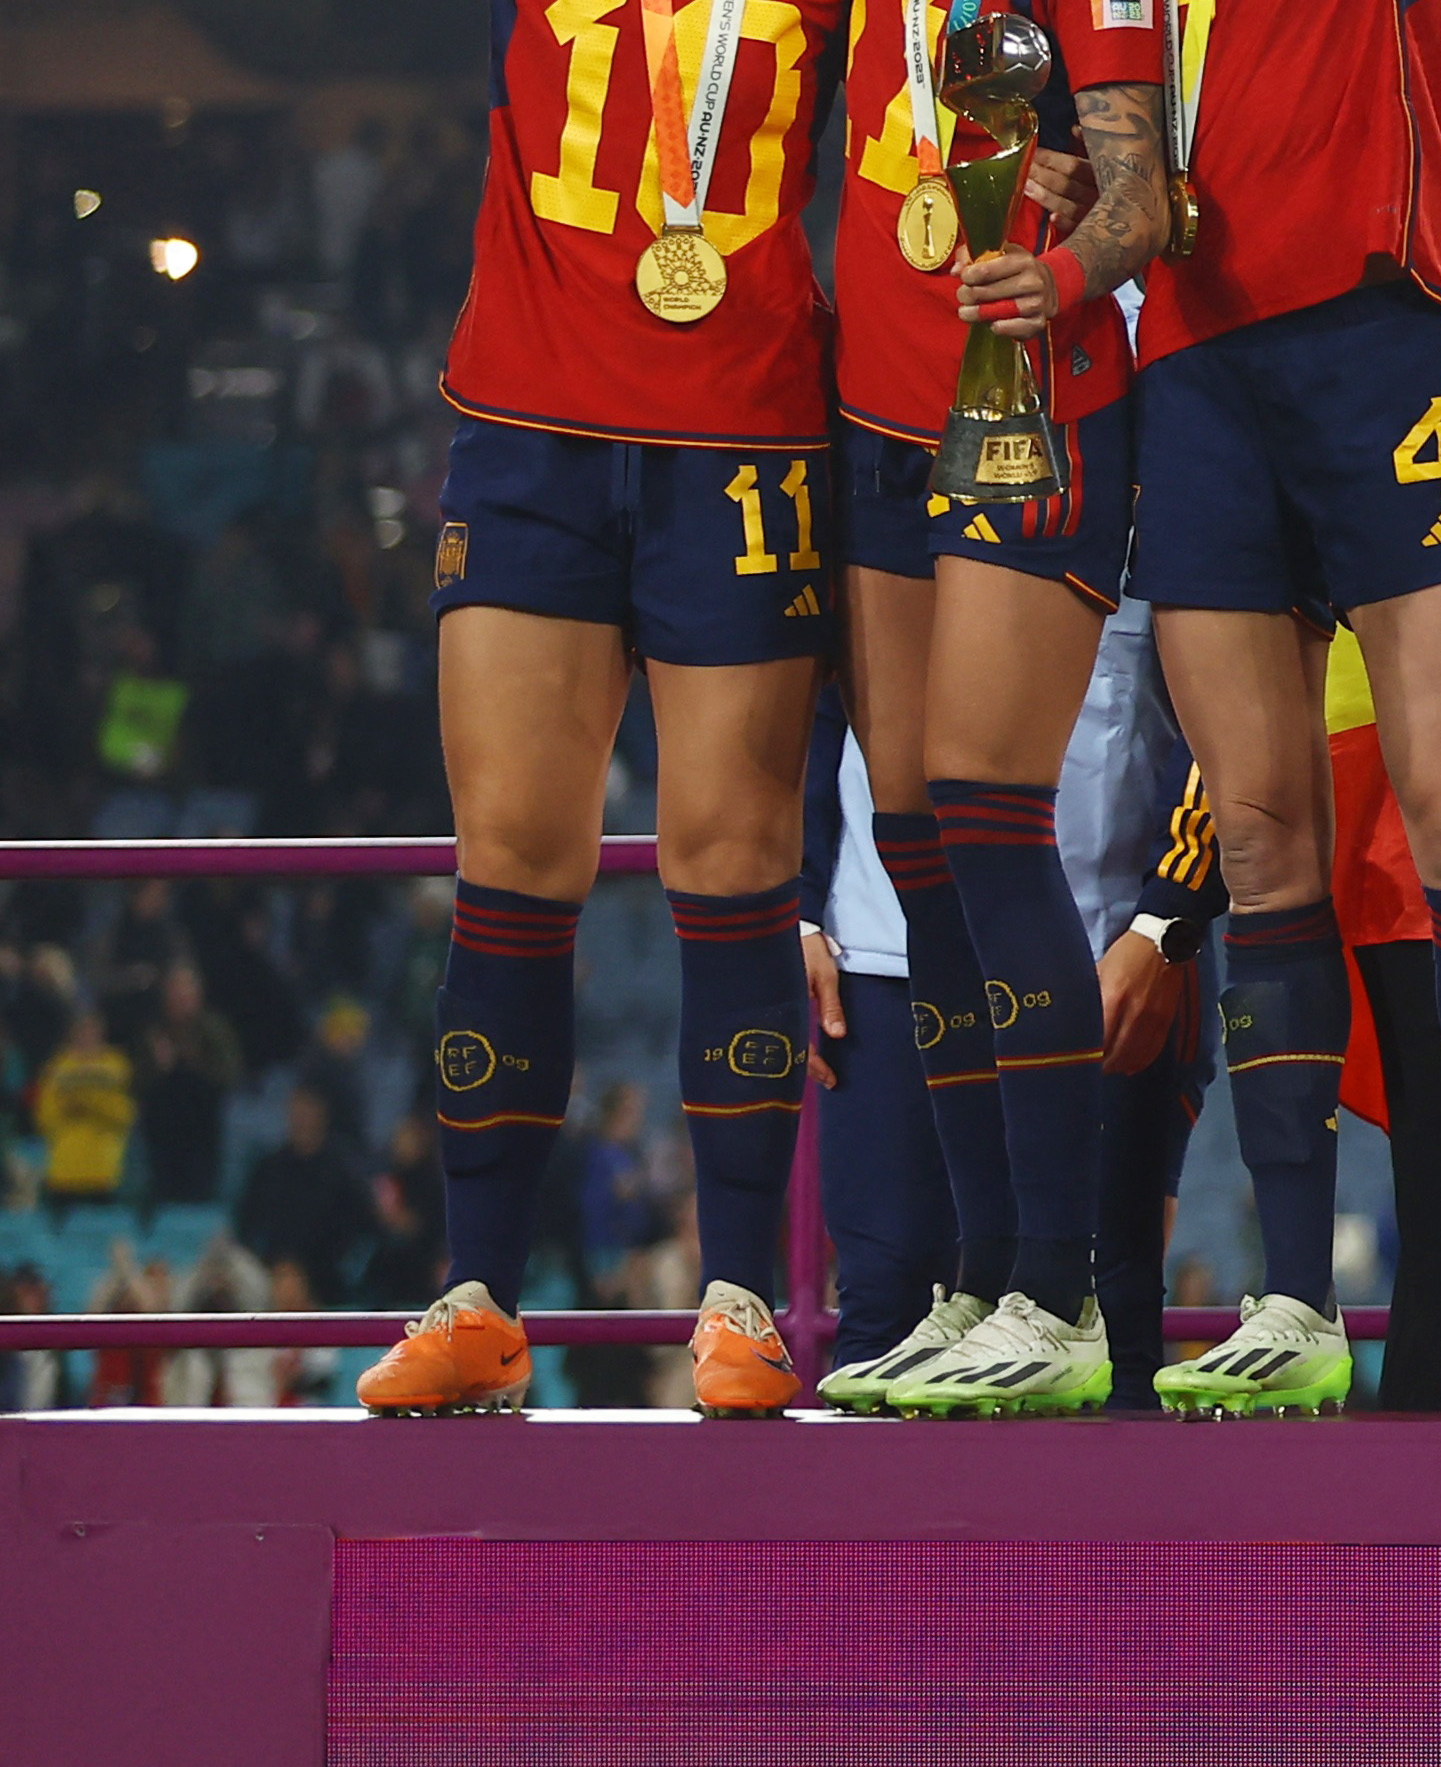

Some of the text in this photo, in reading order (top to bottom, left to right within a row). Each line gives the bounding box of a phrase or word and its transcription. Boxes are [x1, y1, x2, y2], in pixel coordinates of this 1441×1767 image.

[711, 31, 730, 82] WORLD
[704, 82, 719, 111] CUP
[986, 440, 1043, 462] FIFA
[724, 460, 821, 576] 11
[1023, 990, 1051, 1009] 09
[950, 1012, 976, 1028] 09
[1229, 1015, 1252, 1031] 09
[502, 1054, 530, 1072] 09
[703, 1047, 724, 1062] 19
